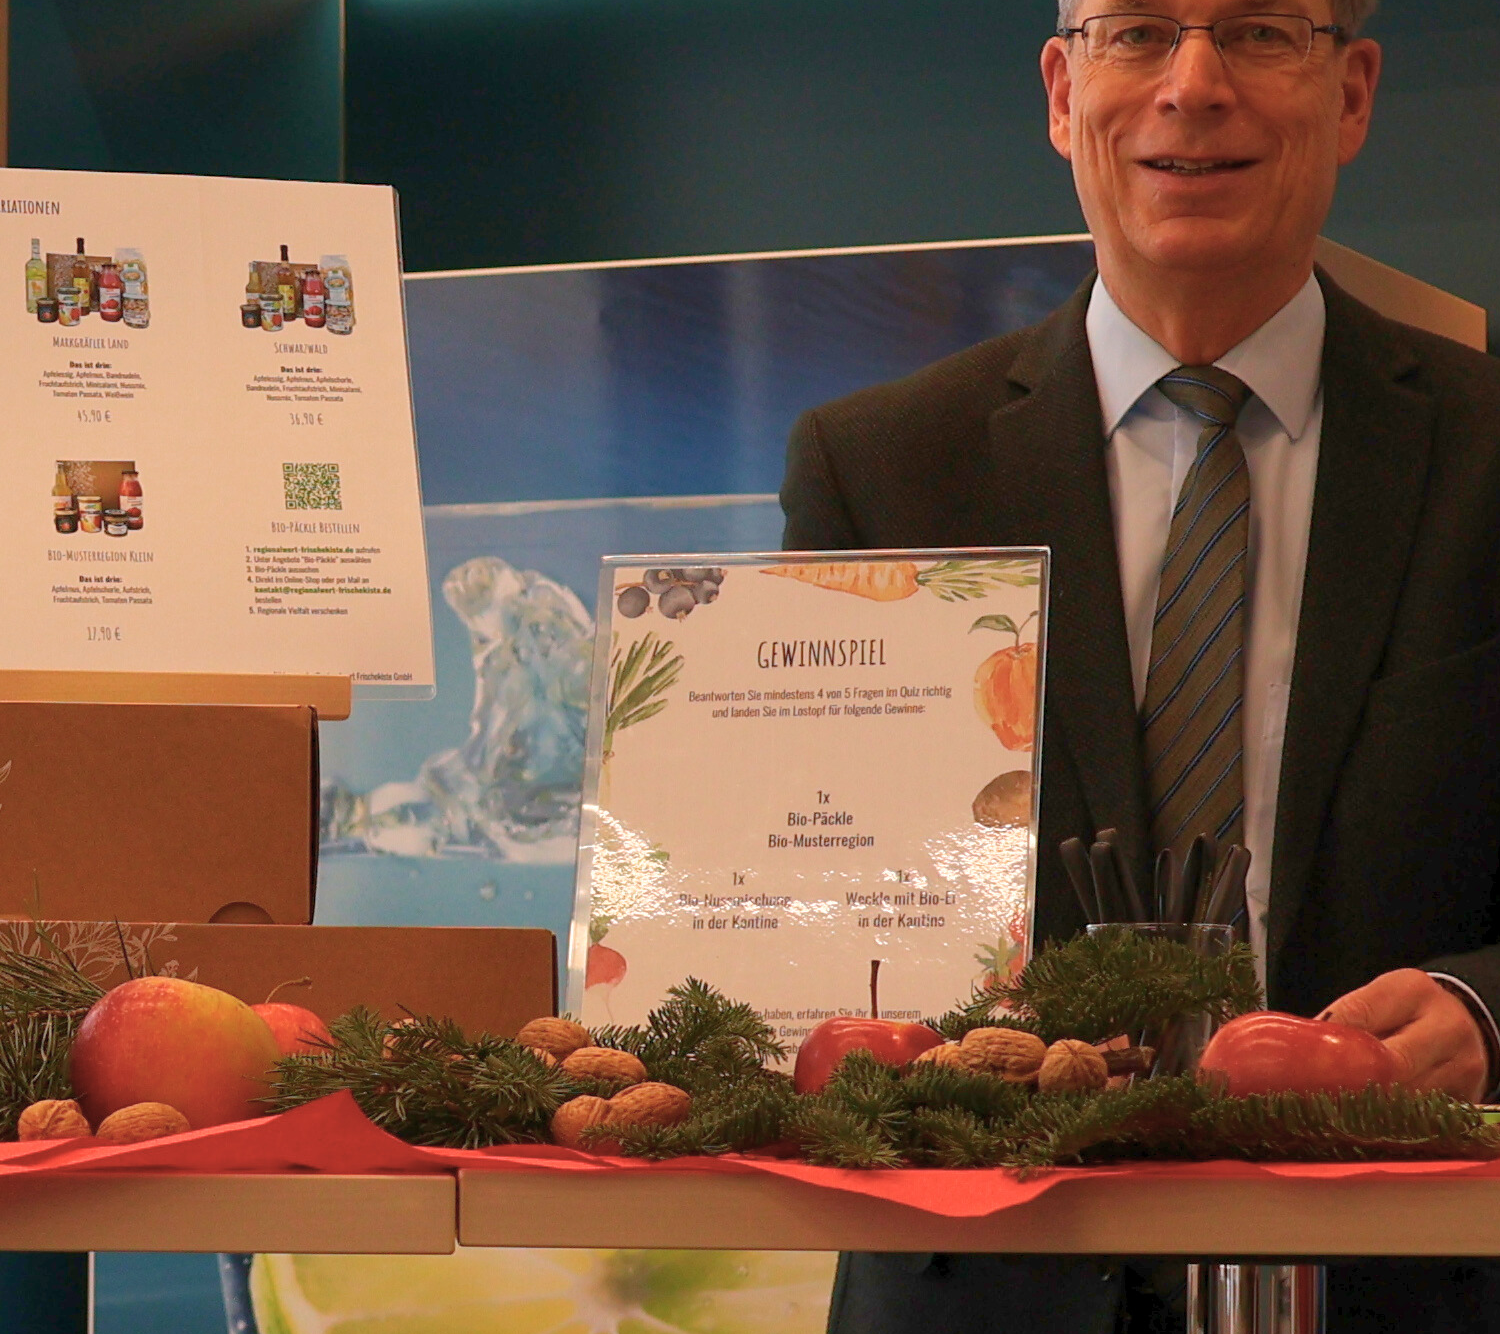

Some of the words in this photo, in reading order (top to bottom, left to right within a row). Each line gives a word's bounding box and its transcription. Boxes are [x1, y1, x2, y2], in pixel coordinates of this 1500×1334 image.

[70, 361, 82, 369] Das
[84, 361, 93, 369] ist
[105, 411, 111, 422] €
[318, 413, 324, 425] €
[347, 576, 360, 584] Mail
[258, 607, 286, 616] Regionale
[115, 627, 121, 641] €
[757, 639, 886, 669] GEWINNSPIEL
[394, 673, 412, 681] GmbH
[689, 691, 745, 702] Beantworten
[747, 690, 761, 701] Sie
[764, 689, 814, 700] mindestens
[817, 689, 824, 699] 4
[826, 690, 841, 699] von
[845, 688, 851, 698] 5
[853, 688, 883, 700] Fragen
[886, 688, 897, 698] im
[900, 687, 919, 699] Quiz
[922, 686, 952, 699] richtig
[712, 707, 728, 719] und
[731, 706, 760, 718] landen
[762, 706, 776, 717] Sie
[779, 705, 790, 717] im
[793, 705, 826, 719] Lostopf
[829, 705, 841, 716] für
[844, 704, 882, 718] folgende
[884, 703, 925, 715] Gewinne:
[817, 790, 830, 804] 1x
[788, 811, 853, 826] Bio-Päckle
[768, 834, 874, 849] Bio-Musterregion
[733, 872, 745, 886] 1x
[897, 870, 911, 883] 1x
[846, 891, 890, 906] Weckle
[894, 891, 915, 905] mit
[692, 917, 704, 929] in
[707, 916, 727, 929] der
[732, 915, 779, 929] Kantine
[858, 916, 869, 927] in
[873, 915, 893, 927] der
[898, 914, 945, 928] Kantine
[765, 1009, 794, 1020] haben,
[797, 1009, 836, 1019] erfahren
[881, 1010, 921, 1019] unserem
